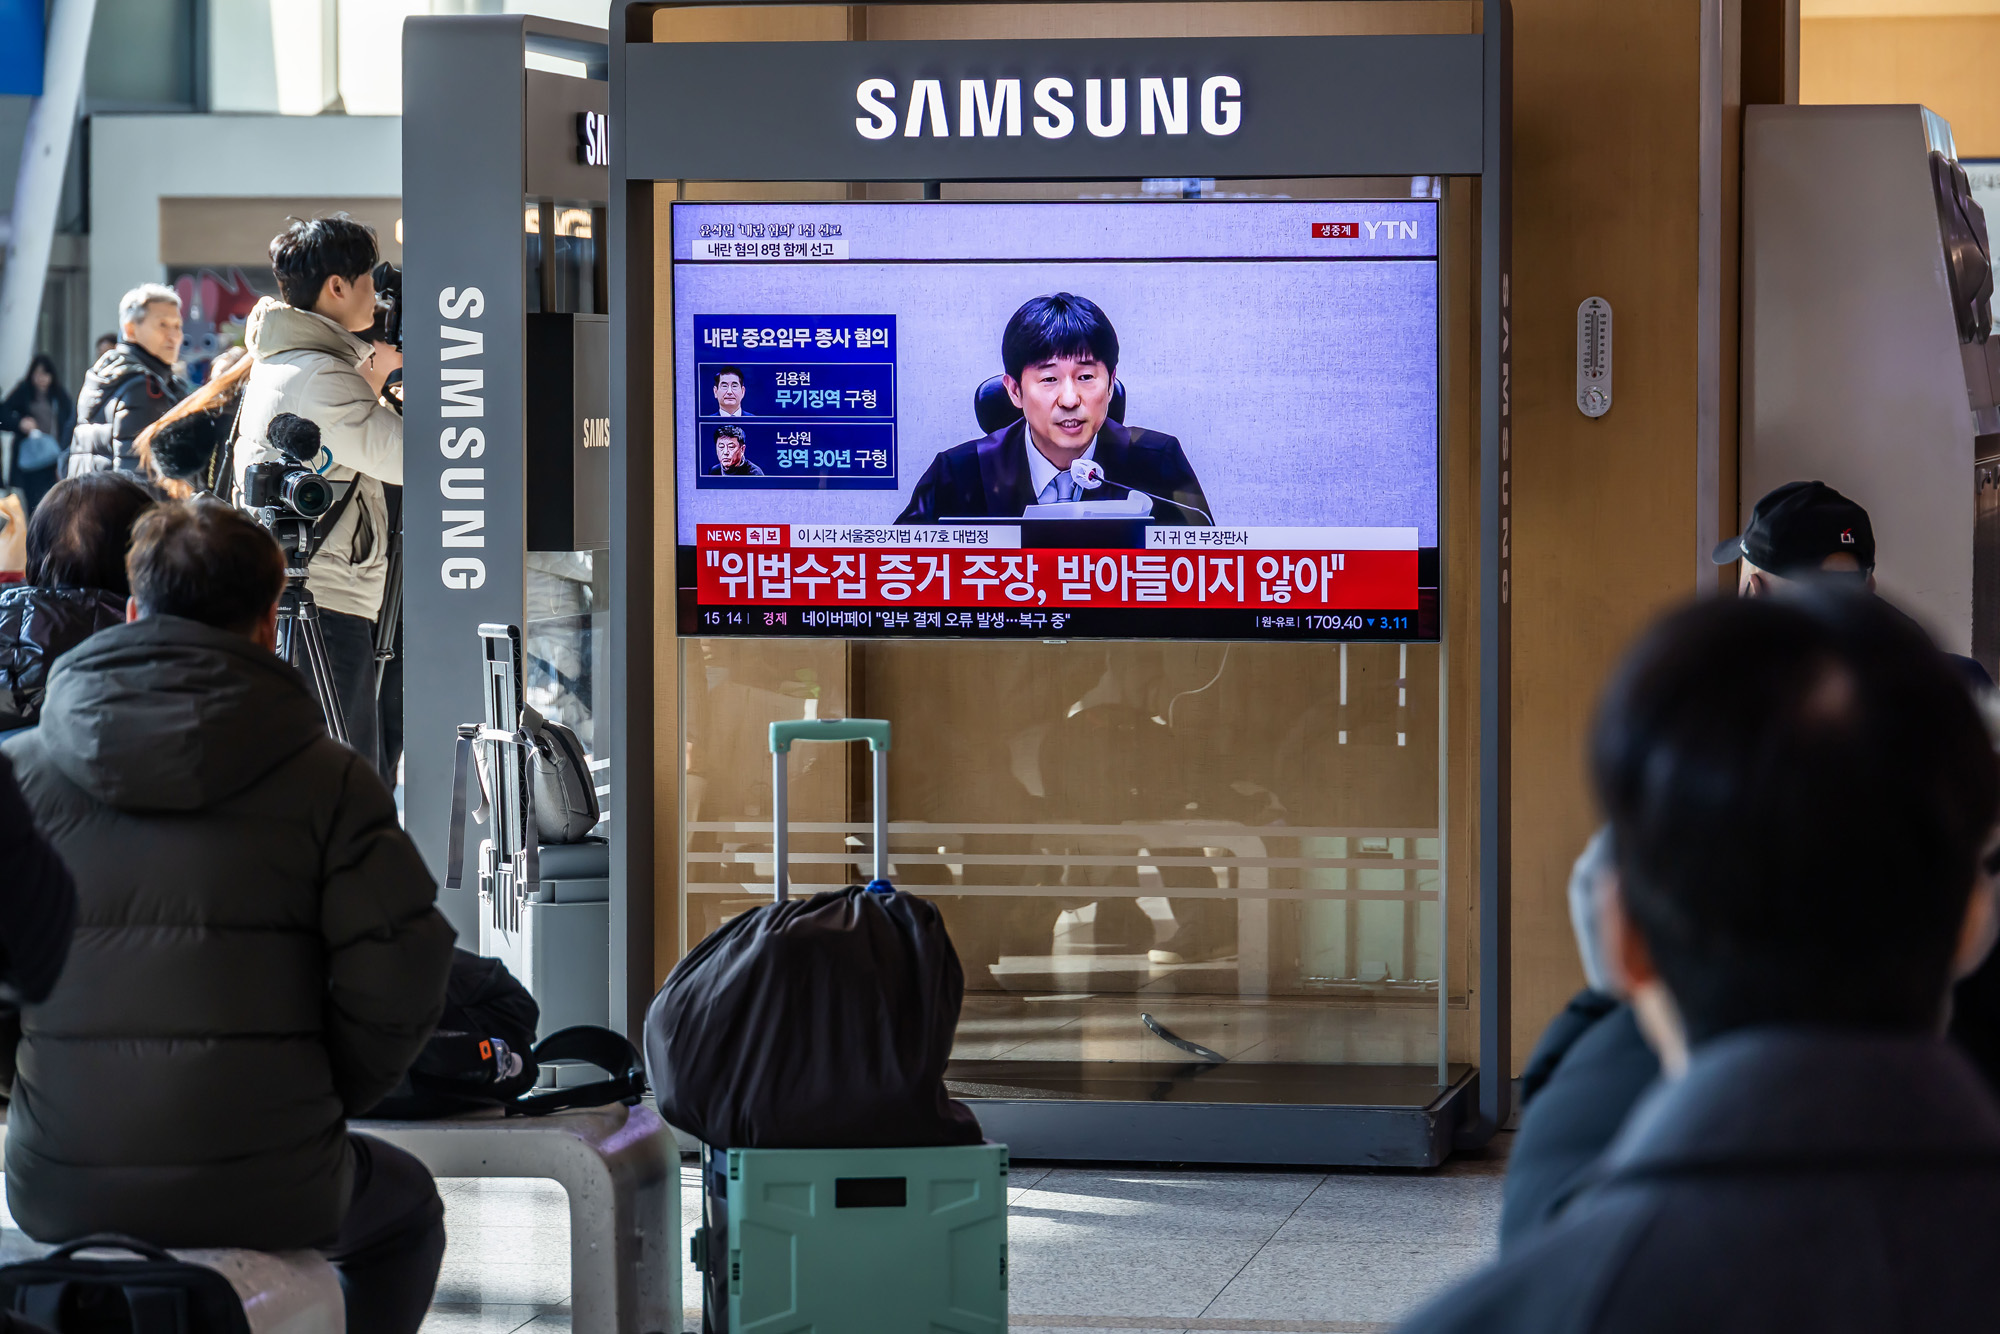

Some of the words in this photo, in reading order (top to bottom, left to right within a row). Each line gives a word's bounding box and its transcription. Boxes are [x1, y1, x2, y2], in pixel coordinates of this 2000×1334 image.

[855, 75, 1241, 140] SAMSUNG
[586, 110, 609, 166] SA
[798, 223, 815, 237] 1심
[818, 223, 842, 237] 선고
[1320, 224, 1351, 237] 생중계
[1363, 220, 1418, 240] YTN
[707, 243, 732, 257] 내란
[734, 243, 758, 257] 혐의
[760, 243, 780, 257] 8명
[783, 243, 807, 257] 함께
[810, 243, 834, 257] 선고
[703, 328, 738, 348] 내란
[741, 328, 812, 348] 중요임무
[814, 328, 851, 348] 종사
[854, 328, 889, 348] 혐의
[775, 372, 811, 386] 김용현
[775, 389, 841, 408] 무기징역
[844, 389, 877, 409] 구형
[438, 286, 486, 590] SAMSUNG
[775, 431, 812, 446] 노상원
[776, 449, 809, 468] 징역
[813, 449, 851, 468] 30년
[854, 449, 887, 469] 구형
[706, 530, 742, 542] NEWS
[798, 529, 810, 543] 이
[813, 529, 838, 543] 시각
[839, 529, 911, 544] 서울중앙지법
[913, 529, 950, 544] 417호
[953, 529, 989, 544] 대법정
[1199, 531, 1248, 545] 부장판사
[706, 550, 867, 600] "위법수집
[876, 554, 950, 601] 증거
[961, 554, 1047, 606] 주장,
[1058, 554, 1245, 602] 받아들이지
[1256, 553, 1345, 604] 않아"
[763, 612, 788, 626] 경제
[802, 610, 872, 628] 네이버페이
[875, 611, 910, 628] "일부
[913, 612, 941, 628] 결제
[944, 612, 973, 628] 오류
[1050, 612, 1071, 629] 중"
[1305, 615, 1363, 629] 1709.40
[1380, 617, 1408, 630] 3.11
